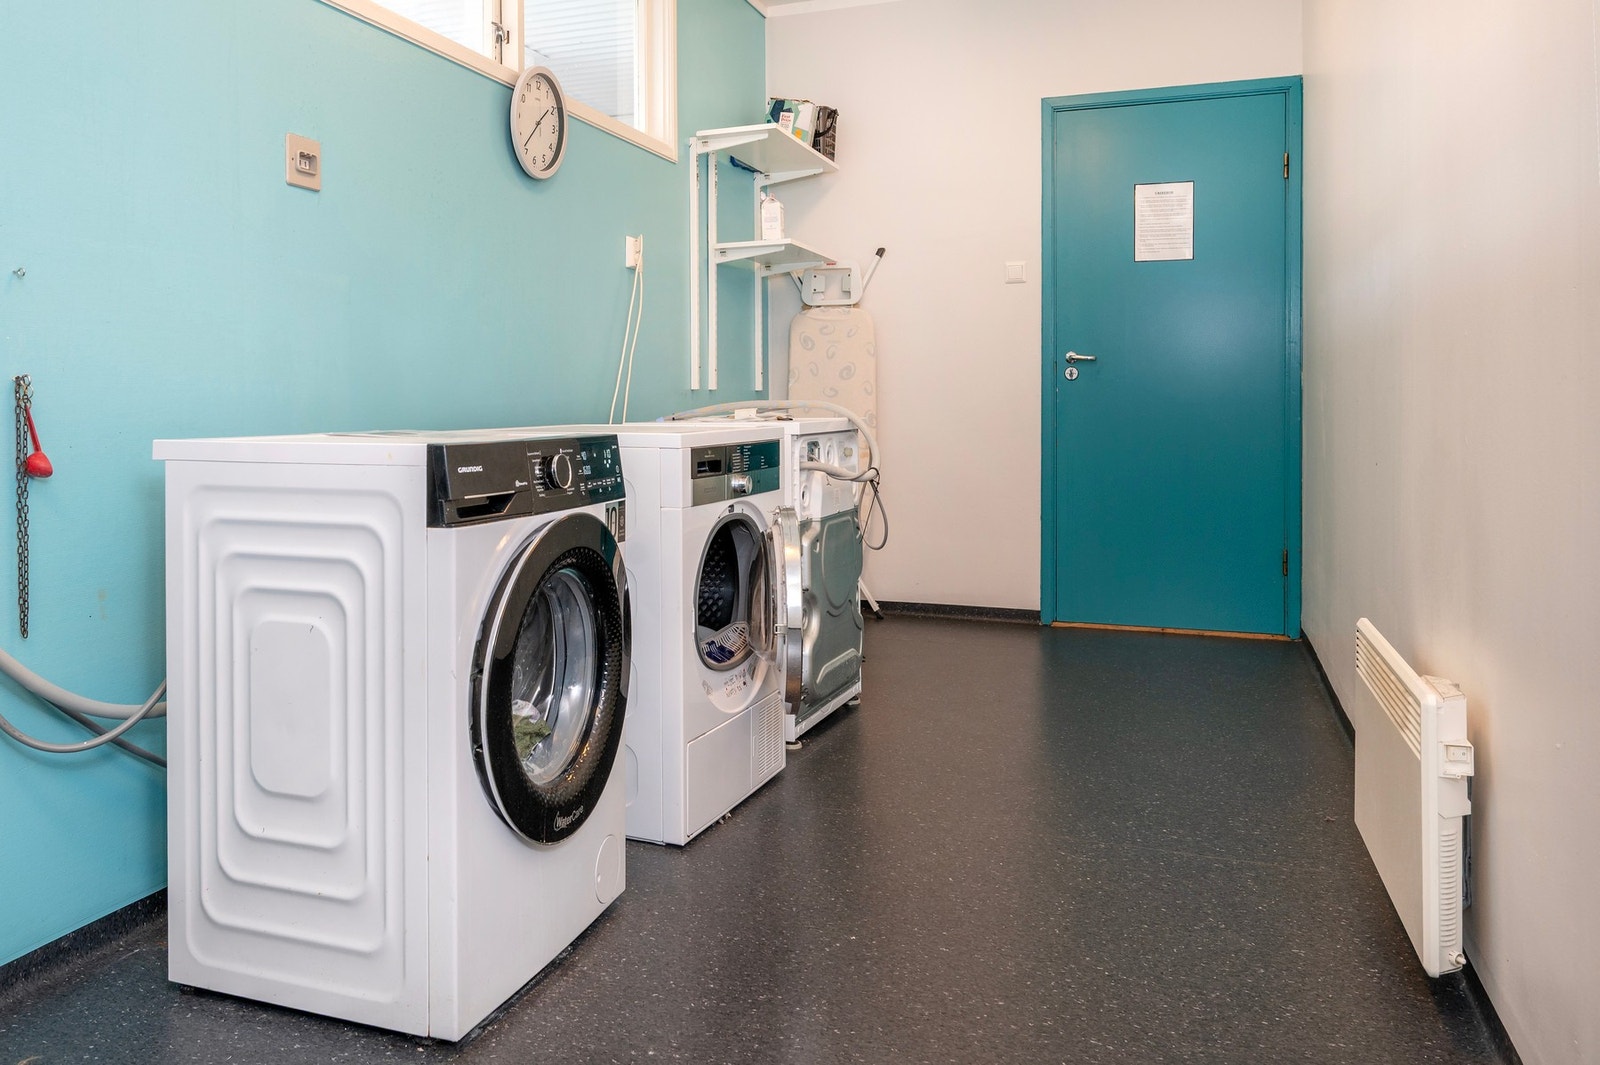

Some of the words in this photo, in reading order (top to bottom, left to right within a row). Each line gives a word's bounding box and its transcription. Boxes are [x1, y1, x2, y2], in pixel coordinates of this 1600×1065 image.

[526, 83, 532, 93] 11
[535, 81, 542, 91] 12
[545, 90, 549, 99] 1
[550, 106, 555, 115] 2
[551, 125, 556, 134] 3
[548, 143, 553, 152] 4
[532, 156, 537, 165] 6
[541, 155, 546, 163] 5
[457, 465, 483, 473] GRUNDIG
